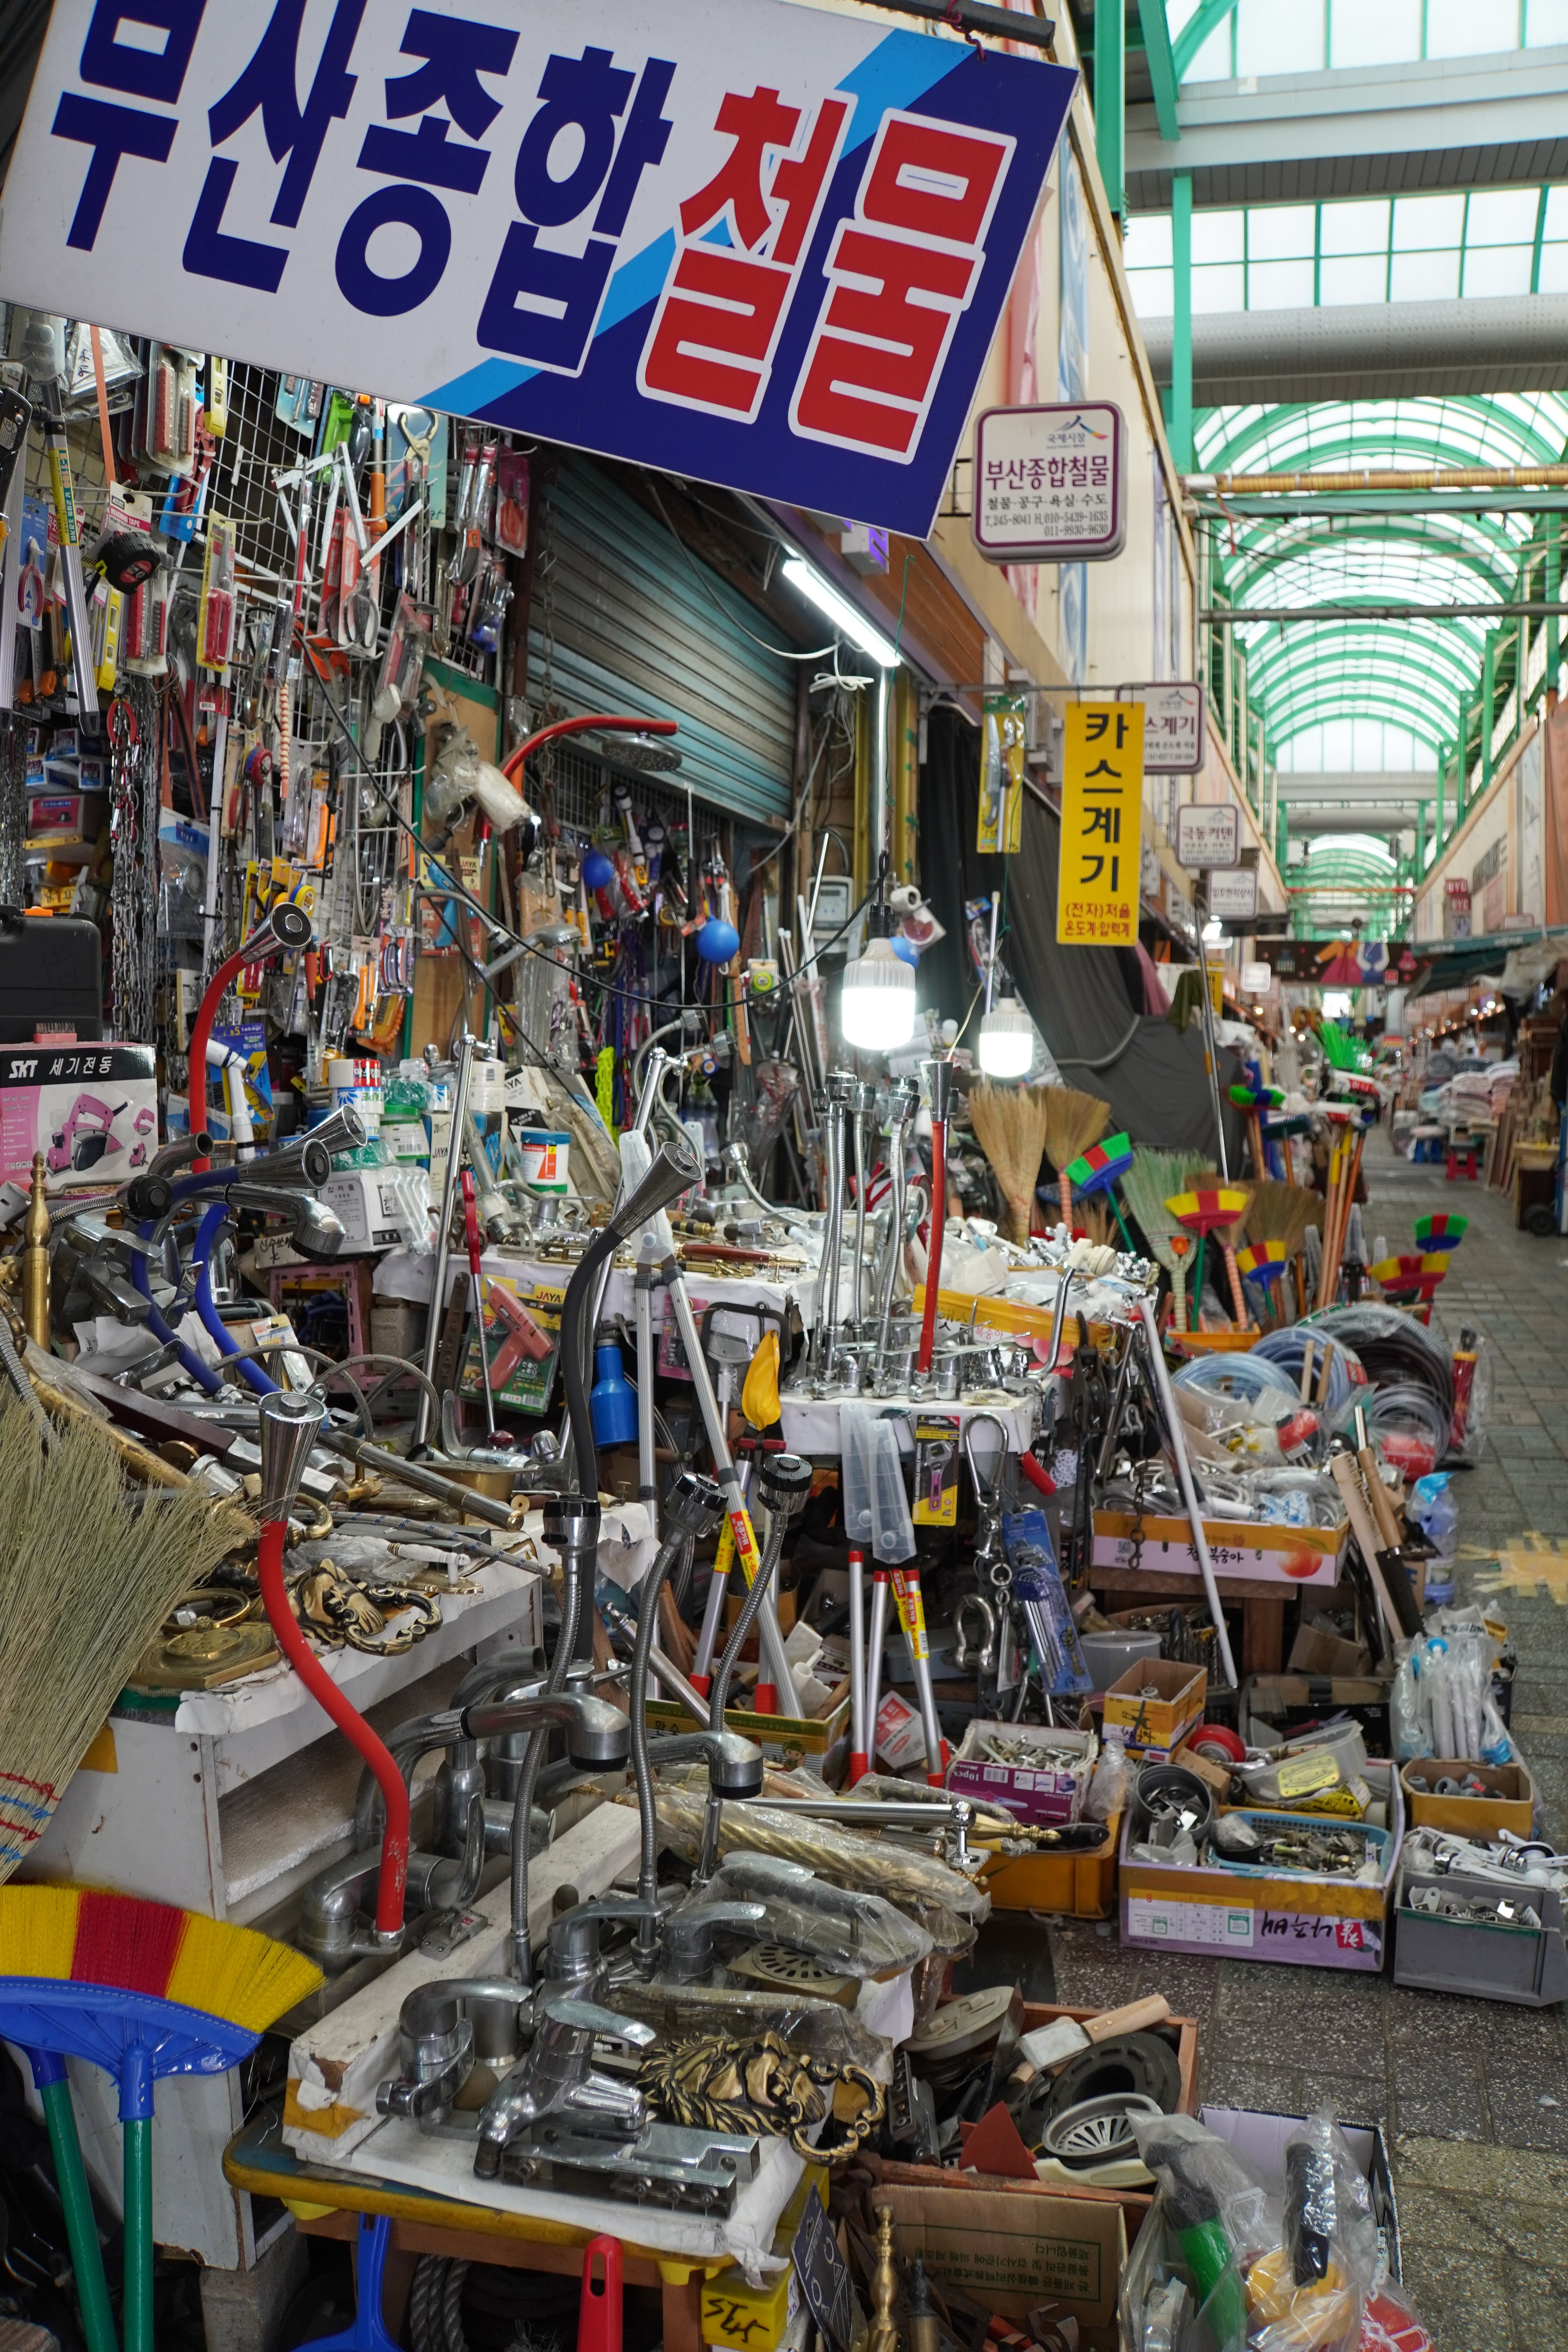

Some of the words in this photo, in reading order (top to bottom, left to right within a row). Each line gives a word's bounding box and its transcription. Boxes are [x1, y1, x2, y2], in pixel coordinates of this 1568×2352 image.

[985, 455, 1109, 490] 부산종합철물
[59, 452, 71, 488] K-1100
[68, 518, 76, 541] 조경가위
[111, 507, 128, 523] MEASURING
[129, 517, 140, 528] TAPE
[119, 521, 132, 531] Quality
[1145, 716, 1195, 735] 스계기
[1080, 713, 1130, 893] 카스계기
[9, 1060, 38, 1079] SKT
[49, 1056, 113, 1076] 세기전동
[432, 1147, 448, 1158] JAYA
[536, 1292, 562, 1303] JAYA
[975, 1325, 1004, 1340] 복숭아
[736, 1520, 749, 1546] 조경가위
[1186, 1543, 1244, 1564] 청복숭아
[893, 1572, 904, 1595] 조경가위
[953, 1770, 980, 1782] 10pcs
[1261, 1910, 1334, 1938] 나주배
[949, 2250, 970, 2262] 의해
[974, 2253, 1027, 2269] 검사기준에
[1031, 2243, 1090, 2261] 제품입니다.
[1031, 2259, 1041, 2270] 및
[1045, 2261, 1089, 2277] 품질관리
[1042, 2276, 1075, 2291] 제품은
